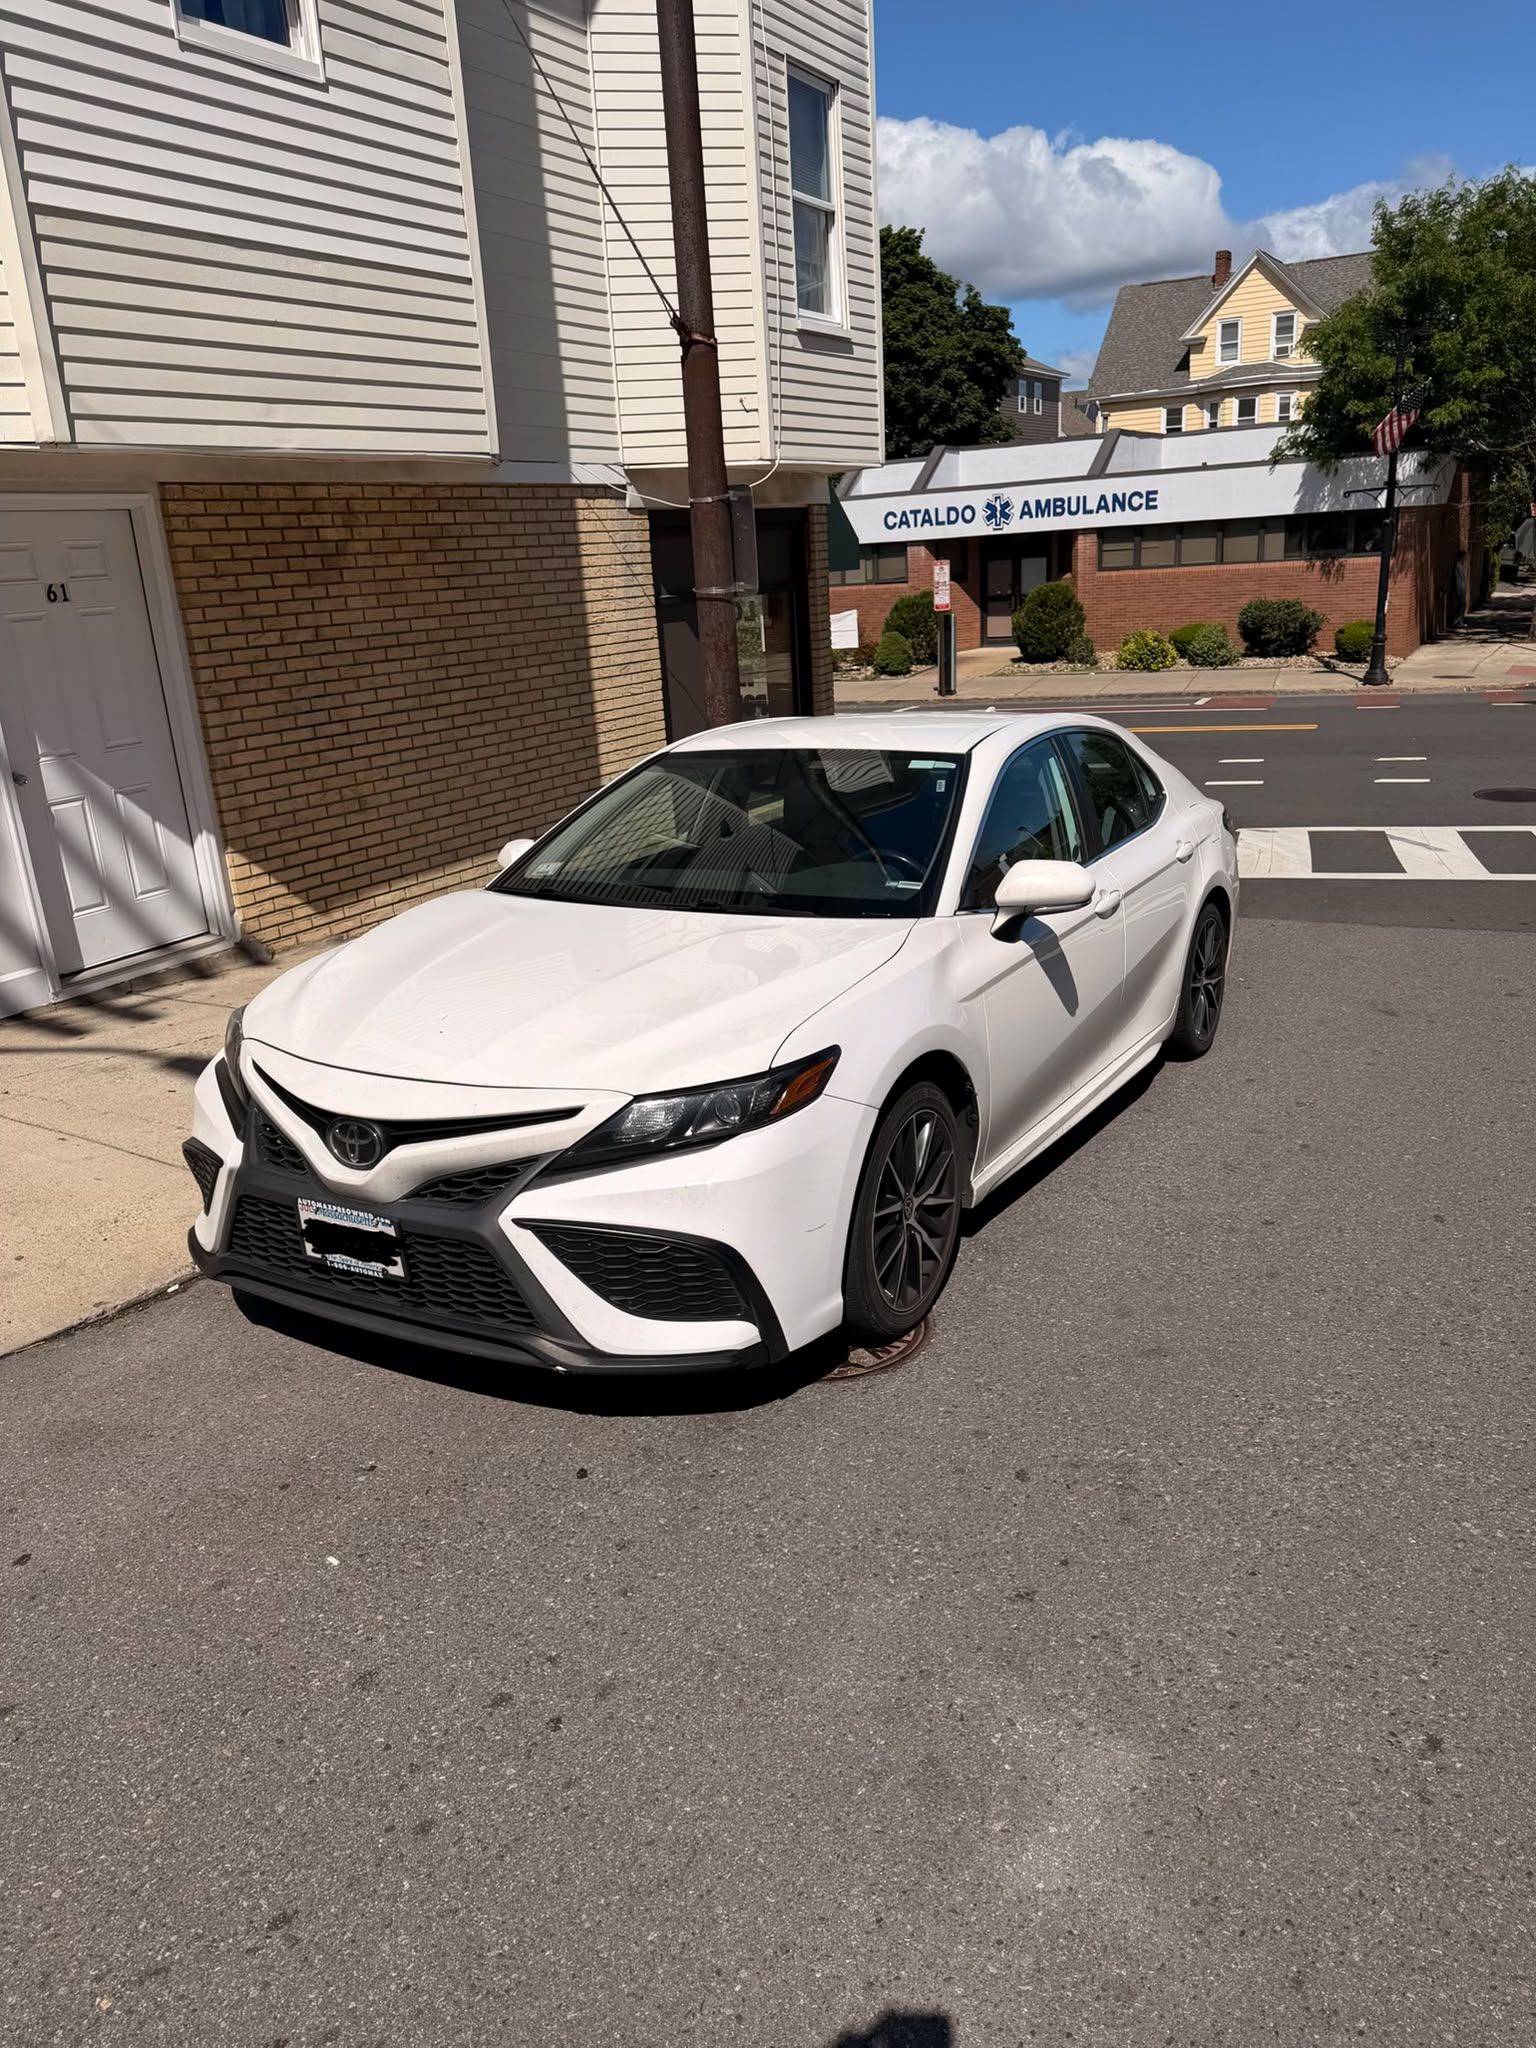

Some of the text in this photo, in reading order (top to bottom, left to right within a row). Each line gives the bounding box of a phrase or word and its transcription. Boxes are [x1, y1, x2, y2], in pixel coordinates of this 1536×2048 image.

[883, 489, 1159, 531] CATALDO AMBULANCE
[46, 583, 70, 603] 61
